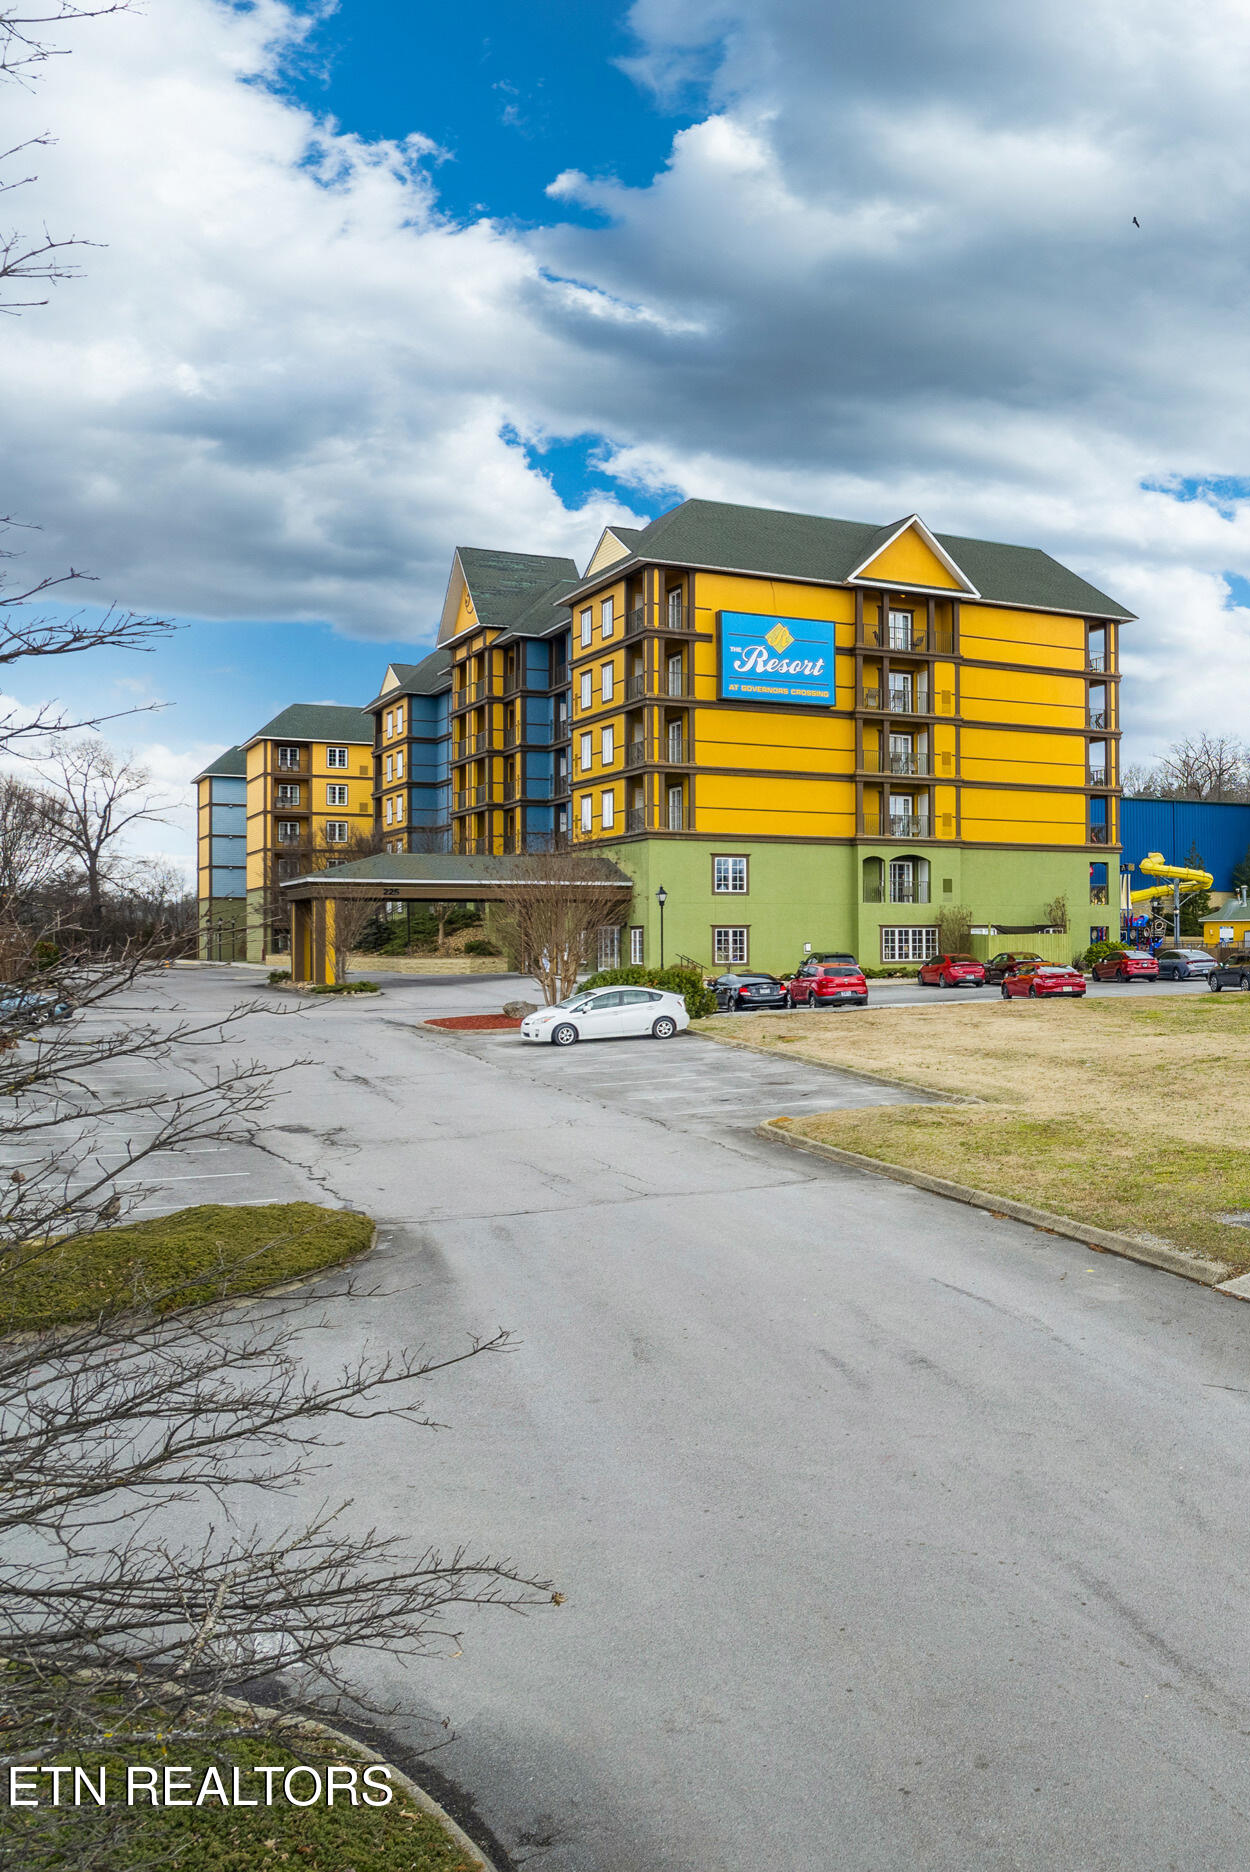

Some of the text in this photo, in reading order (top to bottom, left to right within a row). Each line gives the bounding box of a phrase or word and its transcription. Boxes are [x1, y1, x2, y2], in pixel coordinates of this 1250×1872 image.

[733, 645, 825, 676] Resort
[741, 685, 789, 695] GOVERNORS
[790, 687, 829, 698] CROSSING
[383, 888, 400, 896] 225
